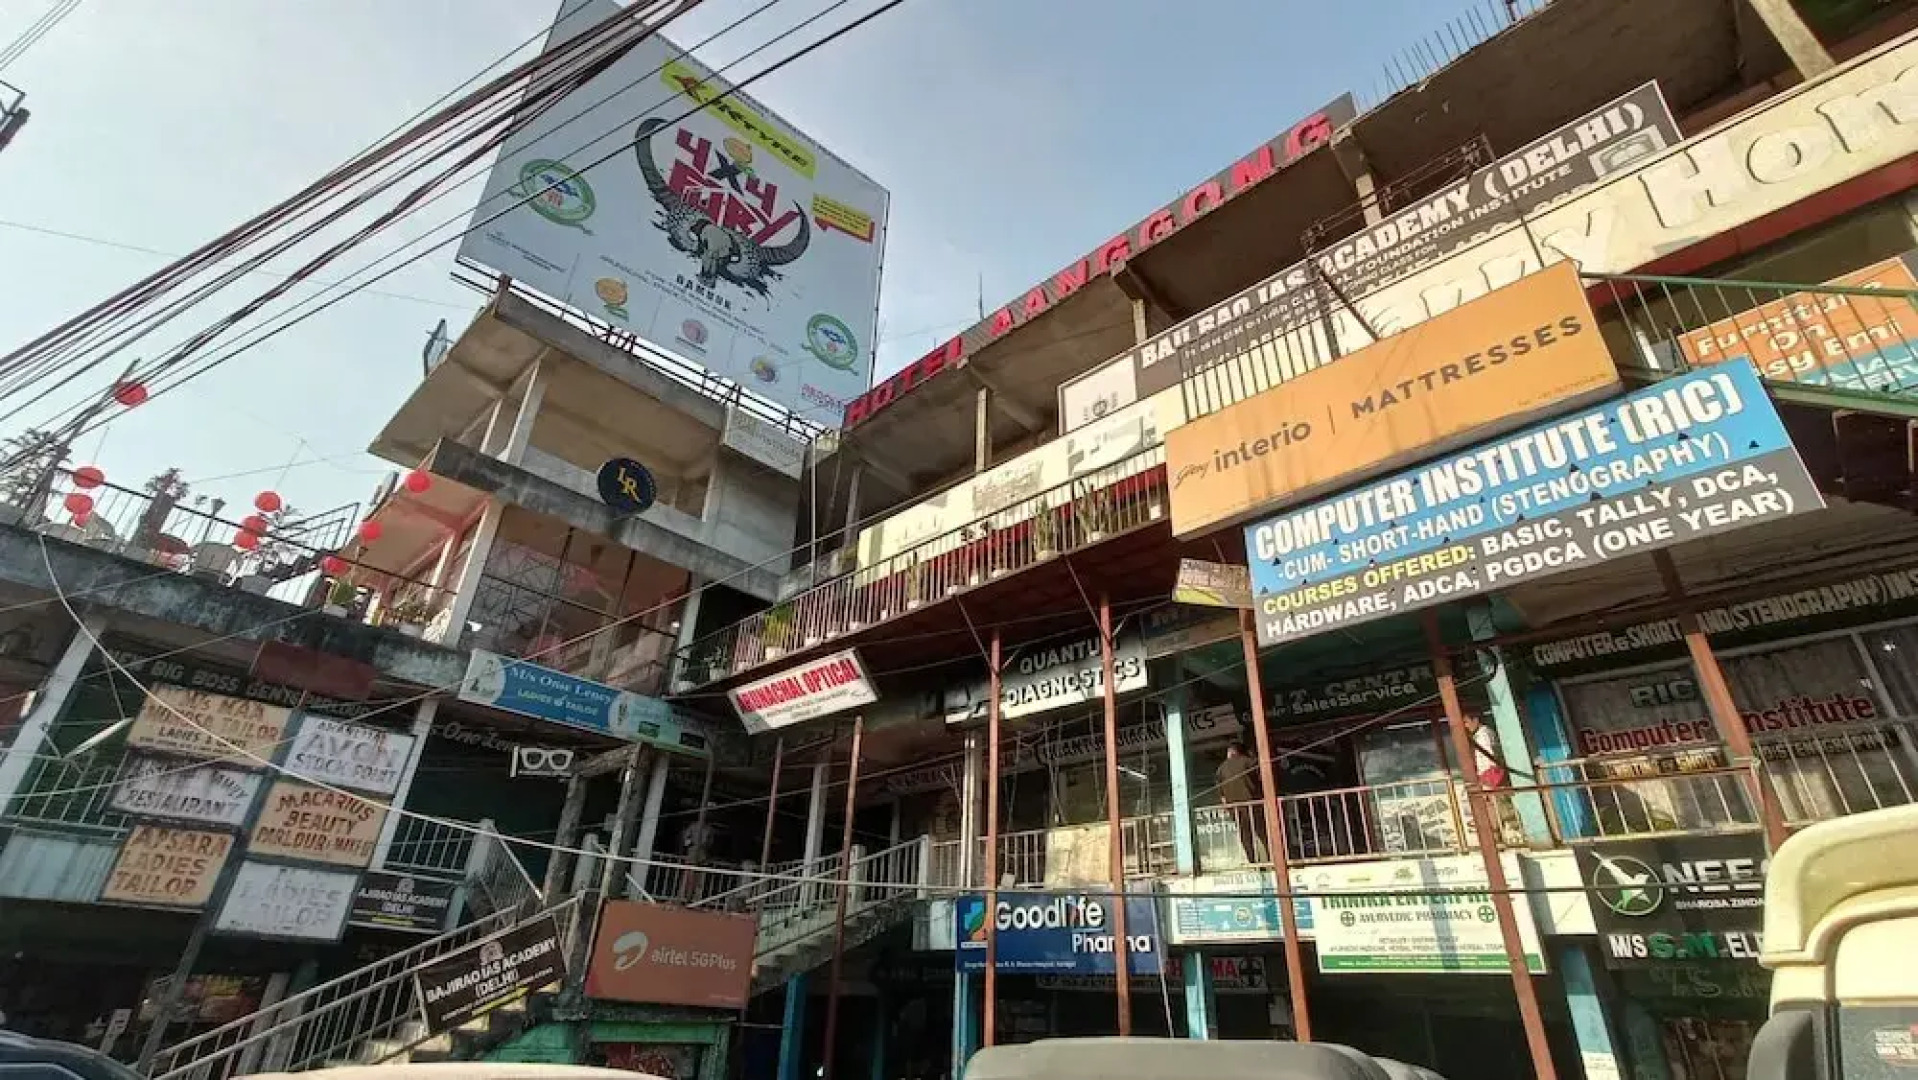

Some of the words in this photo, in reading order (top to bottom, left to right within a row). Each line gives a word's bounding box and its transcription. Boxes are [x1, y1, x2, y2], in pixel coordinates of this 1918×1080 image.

[1484, 100, 1645, 200] (DELHI)
[1469, 162, 1574, 221] INSTITUTE
[1213, 420, 1311, 473] interio
[1350, 315, 1583, 419] MATTRESSES
[1254, 478, 1417, 561] COMPUTER
[1420, 414, 1617, 507] INSTITUTE
[1617, 372, 1744, 444] (RIC)
[1340, 504, 1484, 564] SHORT-HAND
[1491, 431, 1730, 523] (STENOGRAPHY)
[1263, 575, 1359, 615] COURSES
[1363, 546, 1476, 589] OFFERED:
[1480, 518, 1573, 556] BASIC,
[1576, 485, 1688, 530] TALLY,
[1692, 463, 1779, 500] DCA,
[1266, 591, 1397, 638] HARDWARE,
[1485, 541, 1587, 582] PGDCA
[1593, 517, 1676, 559] (ONE
[1679, 488, 1795, 531] YEAR)
[1533, 629, 1614, 667] COMPUTER
[151, 661, 185, 680] BIG
[192, 670, 241, 692] BOSS
[802, 658, 862, 694] OPTICAL
[1006, 655, 1141, 709] DIAGNOSTCS
[1323, 665, 1434, 698] CENTR
[1628, 678, 1696, 708] RIC
[1578, 716, 1710, 755] Computer
[1740, 692, 1876, 733] nstitute
[282, 810, 359, 836] BEAUTY
[119, 850, 209, 876] LADIES
[112, 869, 198, 896] TAILOR
[1416, 909, 1473, 922] PHARMACY
[426, 970, 481, 1004] BAJIRAO
[481, 961, 501, 979] IAS
[502, 936, 556, 970] ACADEMY
[651, 946, 688, 966] airtel
[475, 967, 519, 998] (DELHI)
